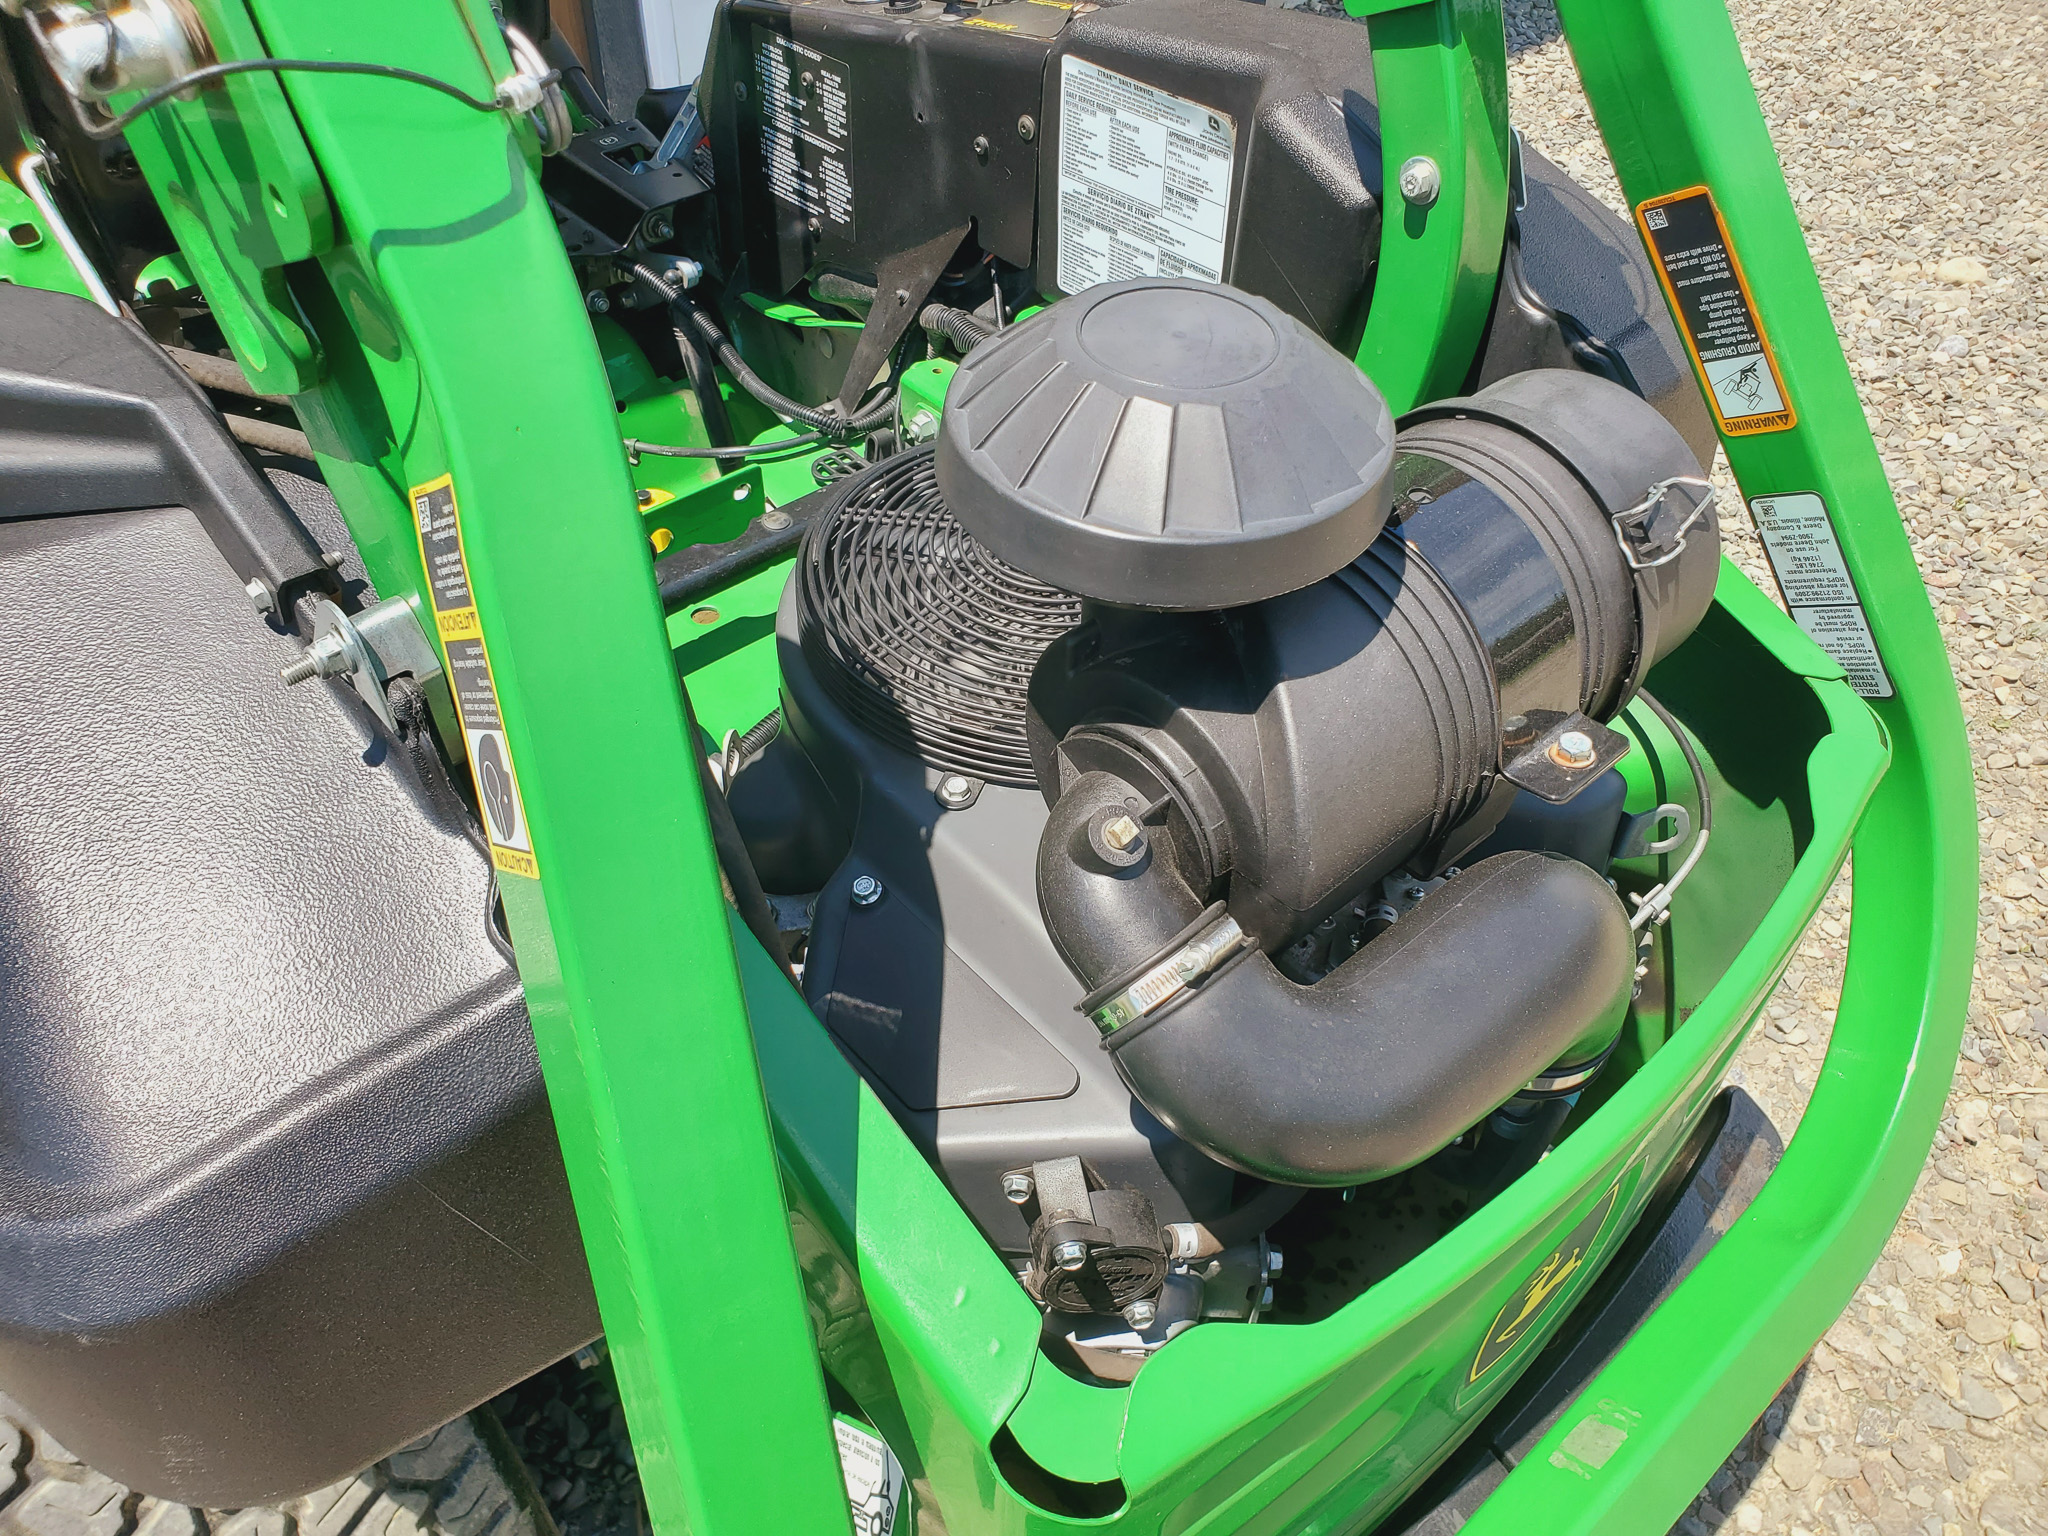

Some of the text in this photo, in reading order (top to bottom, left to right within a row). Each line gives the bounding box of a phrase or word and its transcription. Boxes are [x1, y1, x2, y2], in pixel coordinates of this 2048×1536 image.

[1118, 78, 1132, 88] DAILY
[1134, 84, 1154, 97] SERVICE
[1066, 90, 1077, 100] DAILY
[1078, 95, 1095, 107] SERVICE
[1165, 186, 1174, 195] TIRE
[1088, 188, 1108, 202] SERVICIO
[1110, 197, 1126, 209] DIARIO
[1690, 248, 1702, 256] with
[1702, 244, 1718, 252] Drive
[1700, 255, 1712, 264] NOT
[1712, 253, 1721, 261] DO
[1666, 263, 1677, 271] belt
[1677, 260, 1688, 269] seat
[1704, 264, 1718, 272] down
[1690, 274, 1713, 284] structure
[1714, 271, 1730, 279] When
[1700, 295, 1711, 303] belt
[1711, 292, 1723, 300] seat
[1710, 300, 1732, 309] machine
[1709, 310, 1723, 318] jump
[1708, 319, 1731, 328] extended
[1697, 325, 1748, 338] Protective Structure
[1714, 336, 1736, 344] Rollover
[1700, 342, 1760, 360] AVOID CRUSHING
[1725, 416, 1778, 432] WARNING
